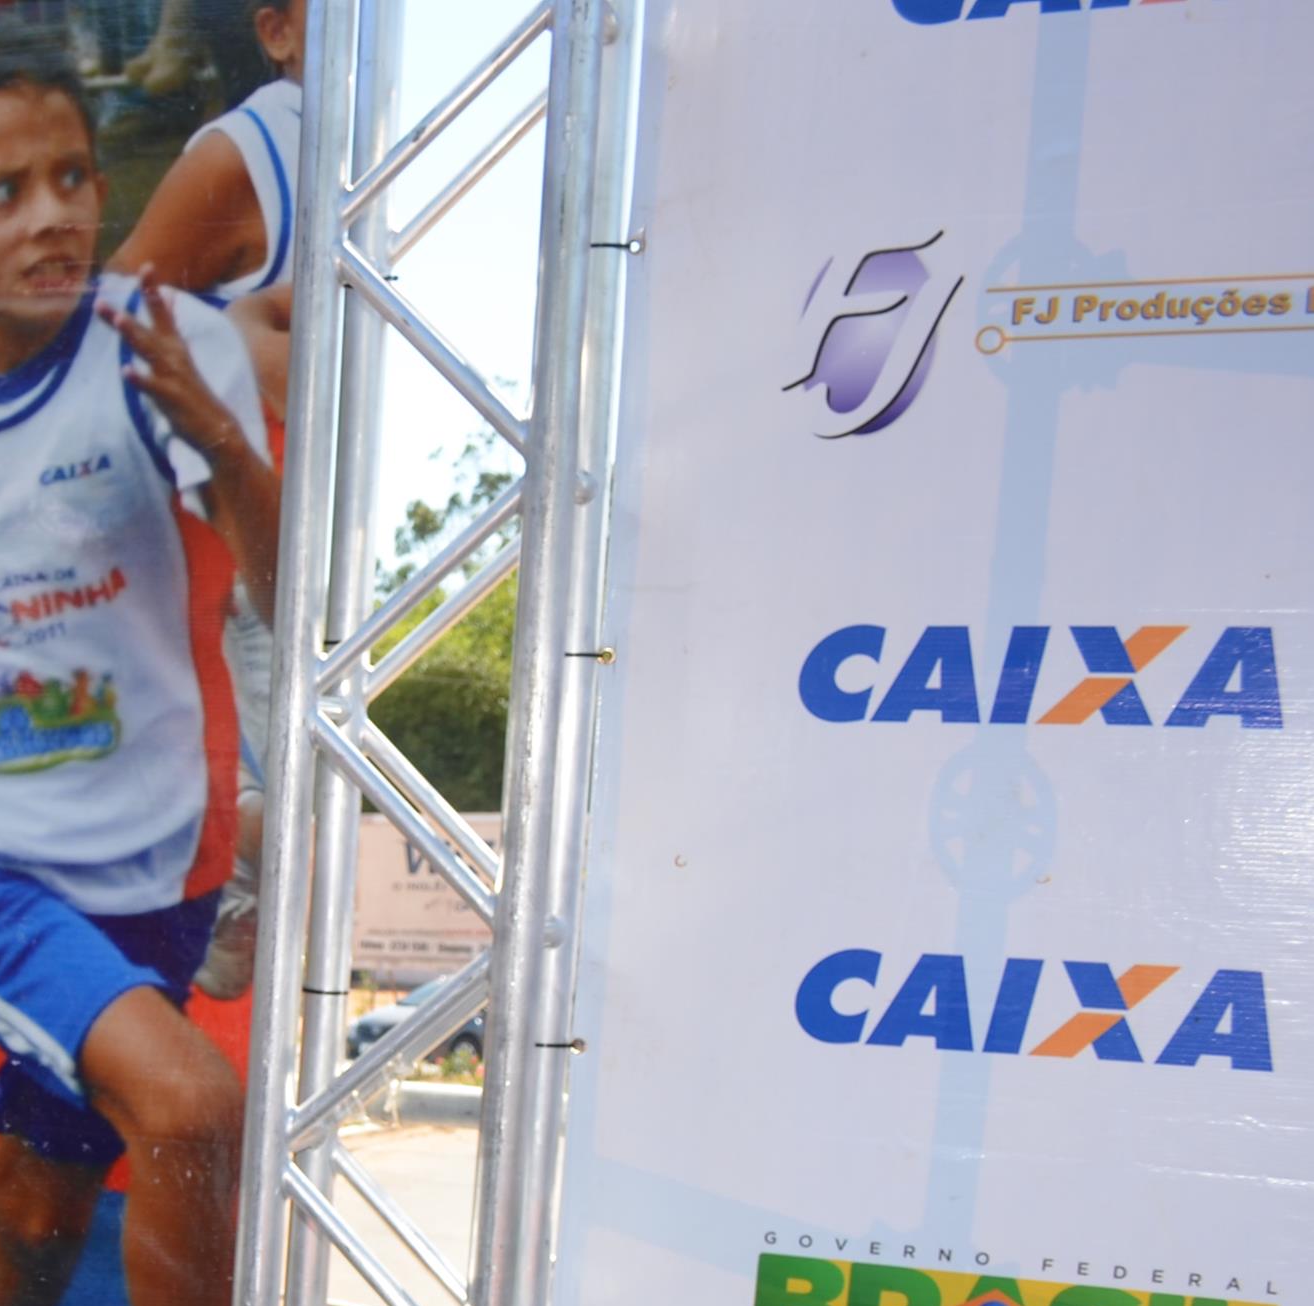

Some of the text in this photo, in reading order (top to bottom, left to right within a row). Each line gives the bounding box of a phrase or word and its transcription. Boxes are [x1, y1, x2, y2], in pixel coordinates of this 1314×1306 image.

[1011, 297, 1060, 325] FJ
[1072, 289, 1292, 325] Produções
[39, 454, 112, 486] CAIXA
[798, 624, 1284, 729] CAIXA
[794, 948, 1274, 1072] CAIXA
[763, 1231, 1279, 1297] GOVERNO FEDERAL
